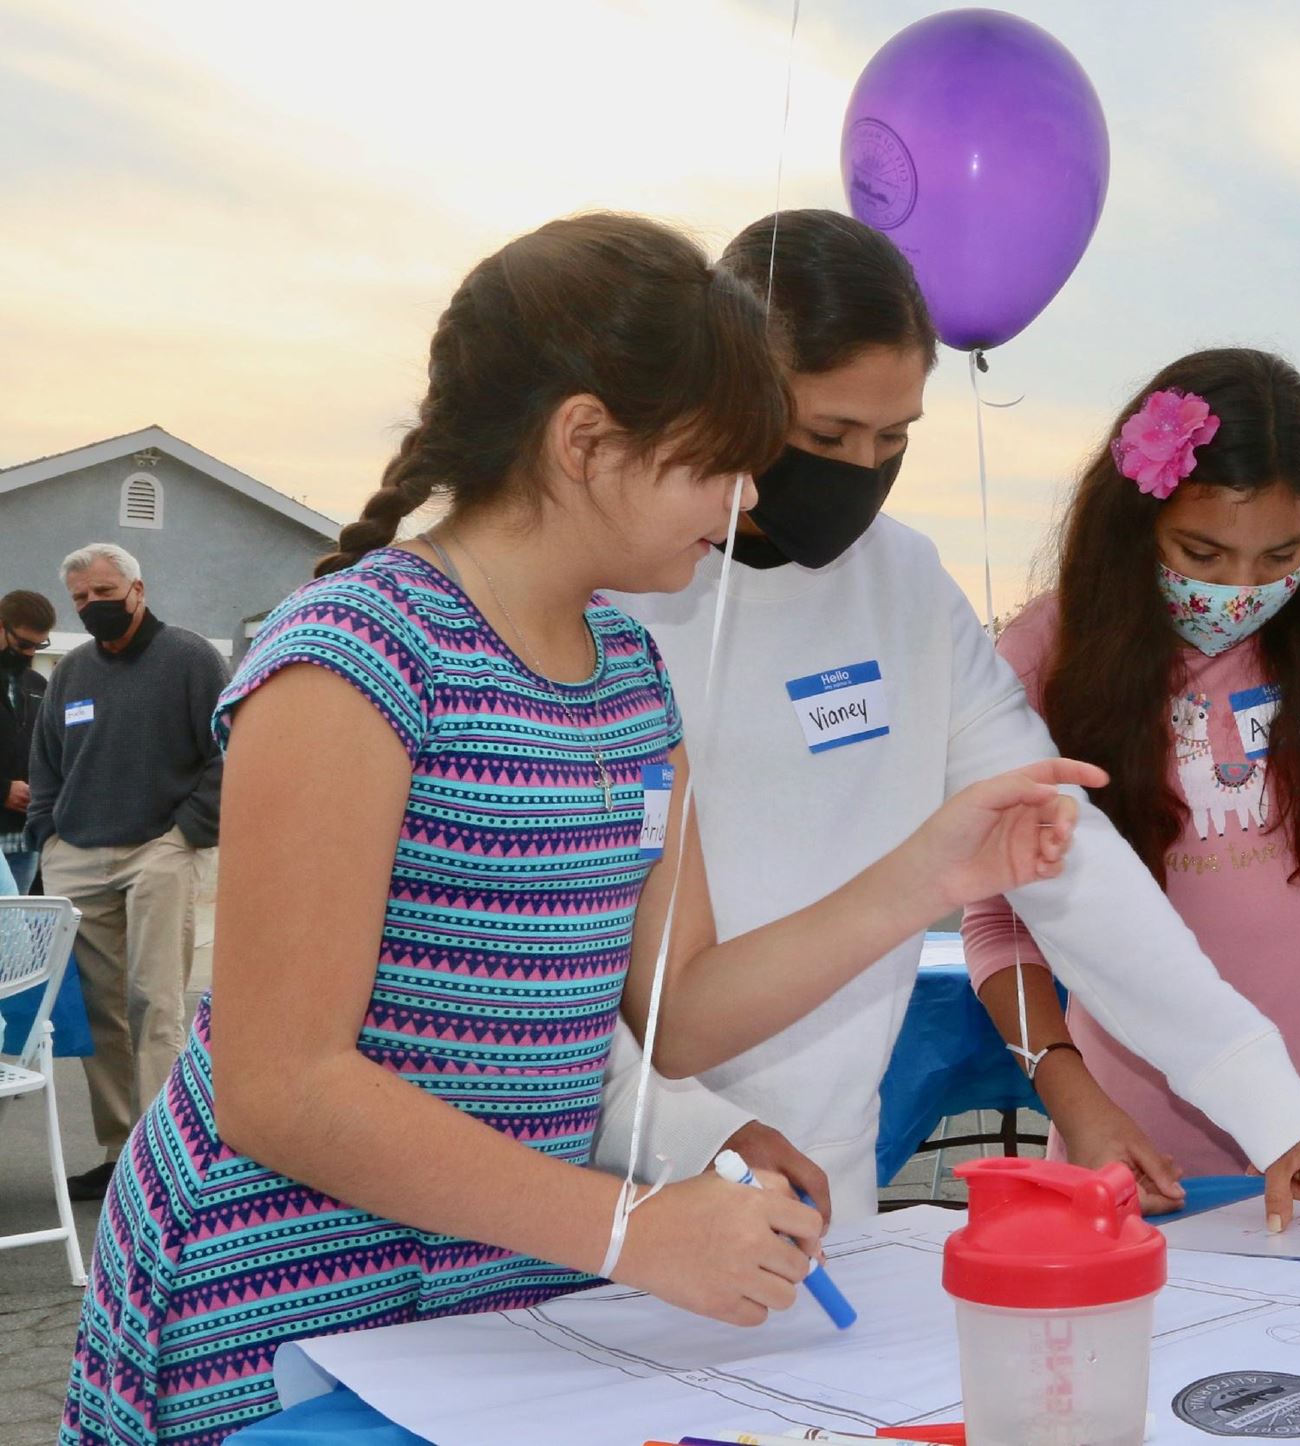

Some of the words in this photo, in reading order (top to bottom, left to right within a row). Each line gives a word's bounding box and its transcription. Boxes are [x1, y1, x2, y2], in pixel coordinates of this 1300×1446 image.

[820, 670, 850, 686] Hello
[809, 698, 868, 732] Vianey
[1189, 1376, 1273, 1411] CALIFORNIA
